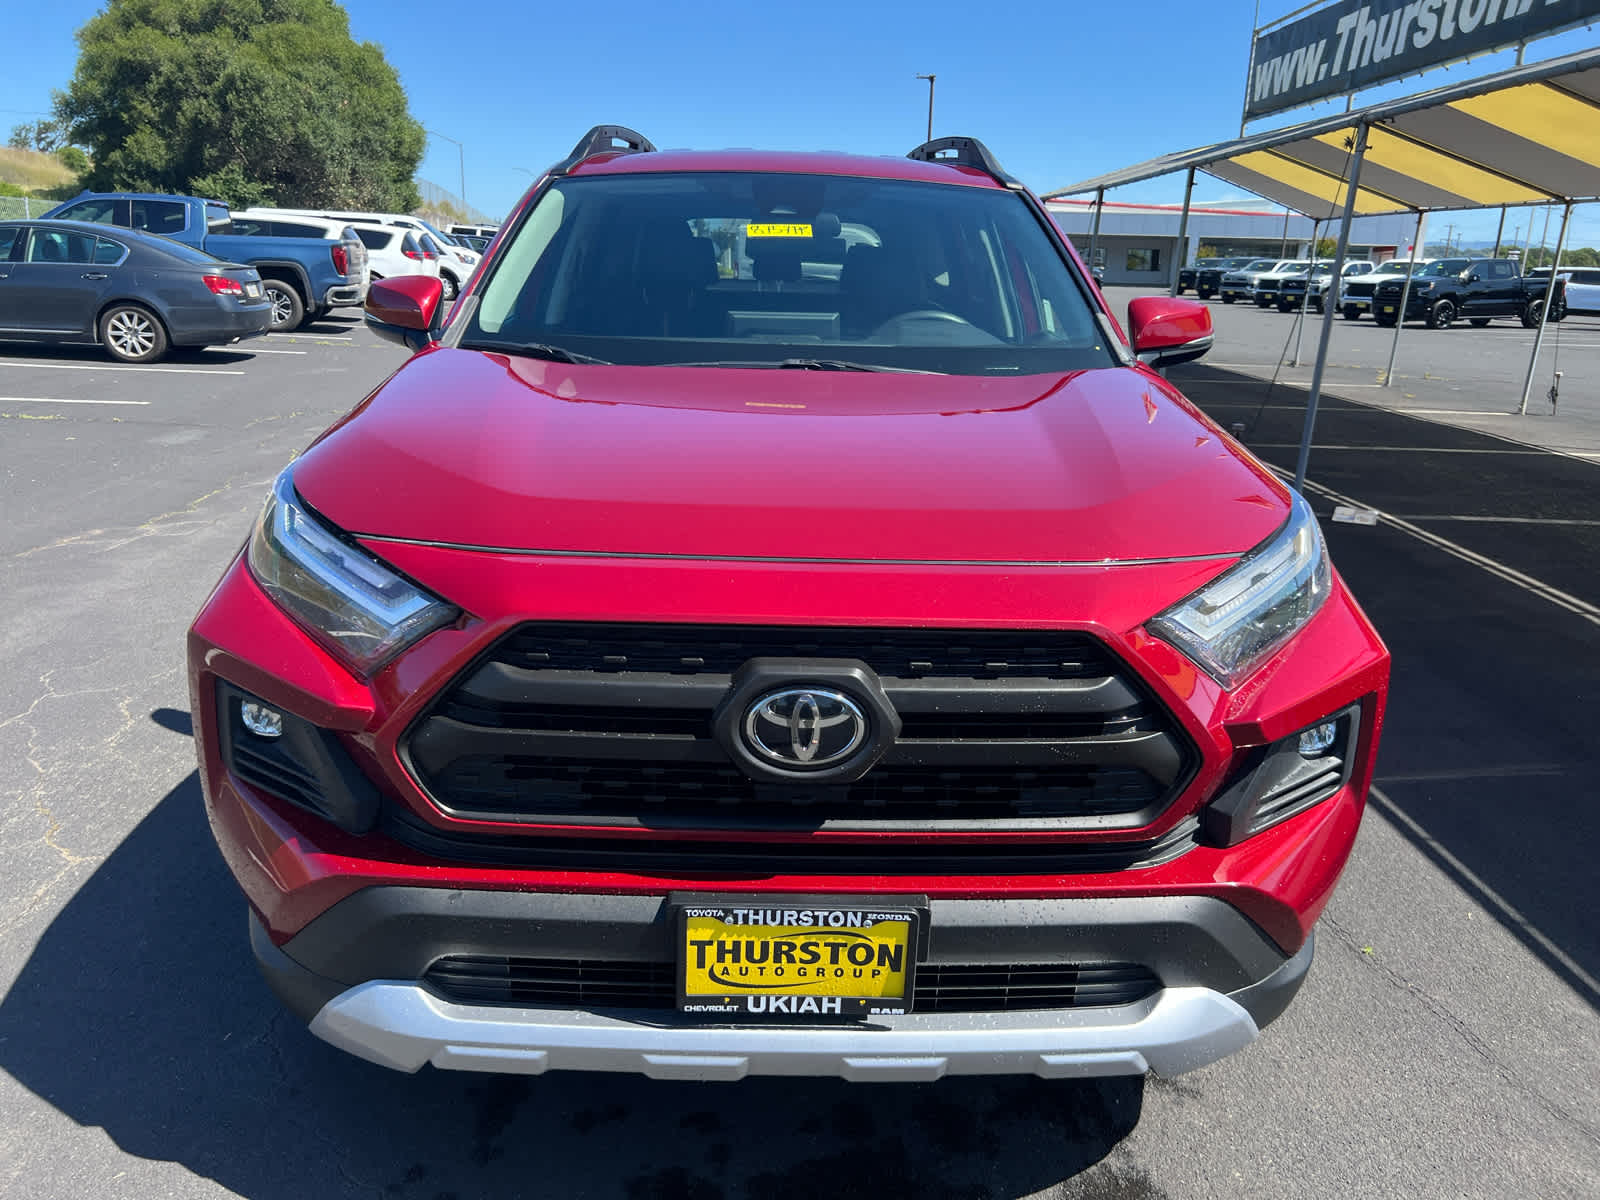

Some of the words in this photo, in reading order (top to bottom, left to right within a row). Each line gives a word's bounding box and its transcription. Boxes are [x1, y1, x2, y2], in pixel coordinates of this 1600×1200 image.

[686, 909, 724, 917] TOYOTA
[733, 909, 862, 928] THURSTON
[867, 913, 911, 921] HONDA
[690, 940, 904, 973] THURSTON
[721, 966, 785, 977] AUTO
[799, 967, 881, 978] GROUP
[747, 996, 842, 1014] UKIAH
